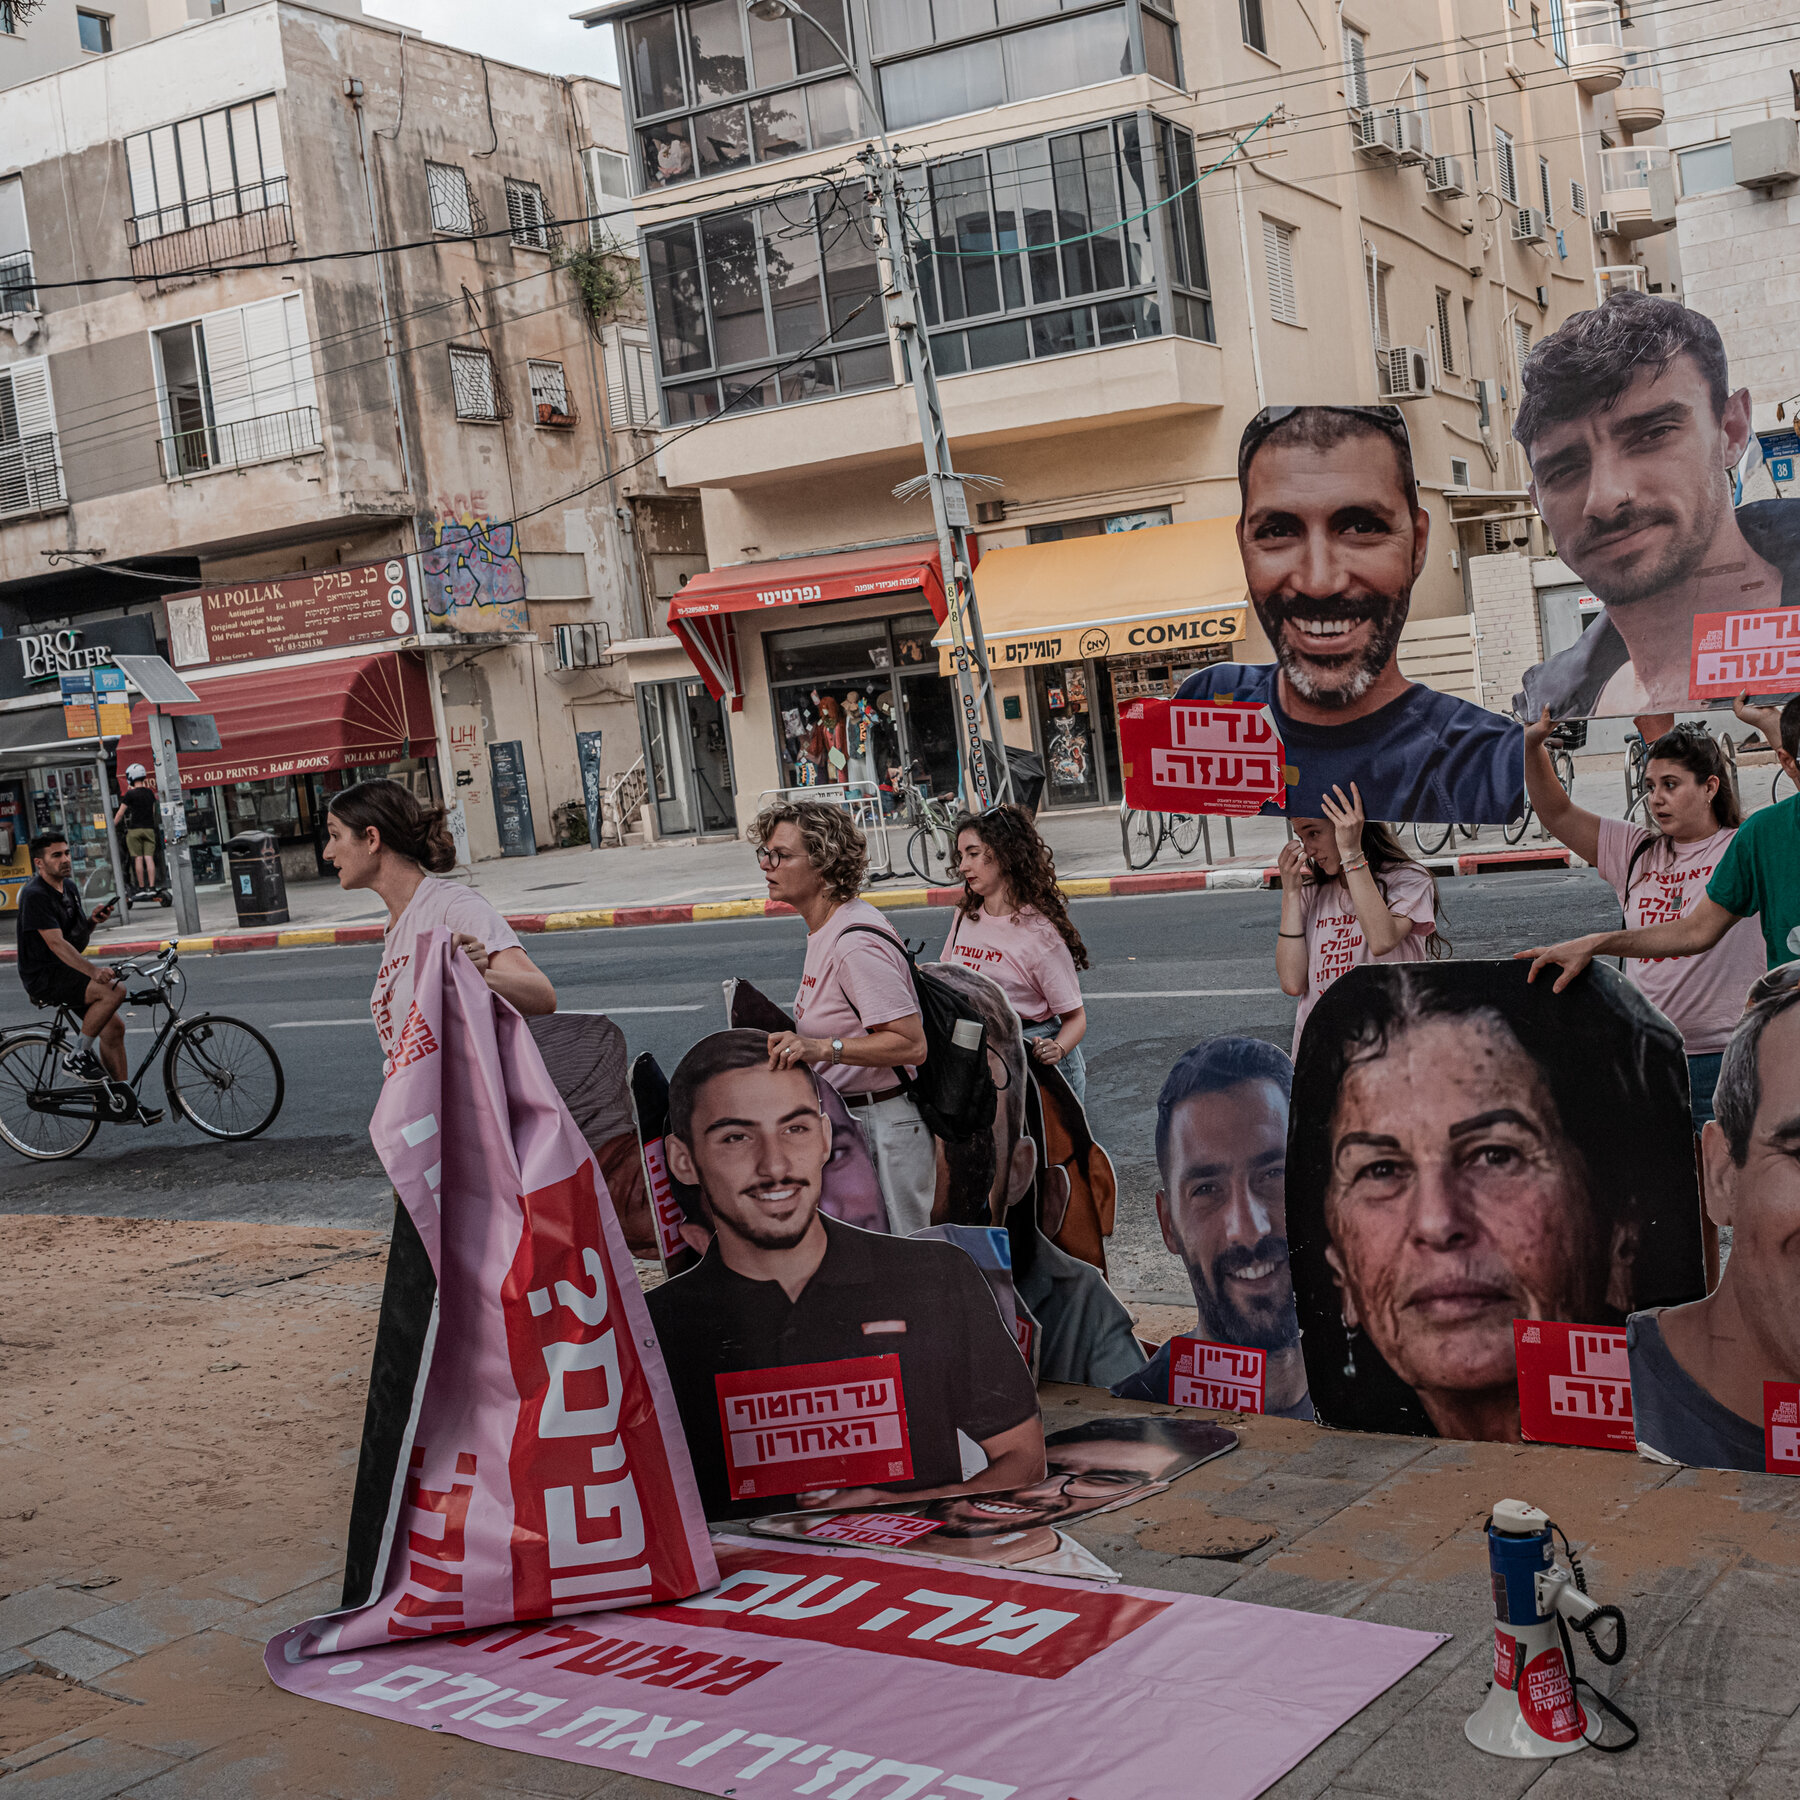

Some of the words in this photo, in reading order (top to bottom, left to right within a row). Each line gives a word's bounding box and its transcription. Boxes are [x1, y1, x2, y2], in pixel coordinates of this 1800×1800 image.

[1777, 463, 1788, 477] 38
[312, 570, 352, 597] פולק
[360, 567, 378, 584] מ.
[854, 583, 875, 593] אופנה
[900, 576, 920, 586] אופנה
[207, 583, 284, 610] M.POLLAK
[276, 602, 288, 611] Est.
[756, 585, 822, 606] נפרטיטי
[210, 621, 238, 632] Original
[240, 617, 265, 628] Antique
[266, 614, 284, 624] Maps
[228, 606, 265, 618] Antiquariat
[212, 633, 224, 642] Old
[225, 630, 245, 641] Prints
[250, 628, 265, 636] Rare
[267, 625, 286, 635] Books
[1128, 616, 1237, 646] COMICS
[17, 630, 76, 679] PRO
[31, 645, 112, 676] CENTER
[1005, 638, 1062, 663] קומיקס
[1175, 711, 1272, 745] עדיין
[204, 771, 223, 782] OLD
[226, 765, 259, 779] PRINTS
[270, 760, 294, 774] RARE
[296, 755, 329, 769] BOOKS
[1155, 754, 1275, 788] בעזה.
[985, 950, 1002, 963] לא
[1199, 1348, 1259, 1379] עדיין
[733, 1389, 839, 1425] החטוף
[843, 1383, 888, 1408] עד
[1182, 1381, 1259, 1415] בעזה.
[756, 1421, 877, 1462] האחרון
[859, 1515, 933, 1532] עדיין
[675, 1569, 881, 1620] עם
[857, 1588, 1080, 1655] מה
[351, 1664, 569, 1729] כולם
[537, 1705, 705, 1758] את
